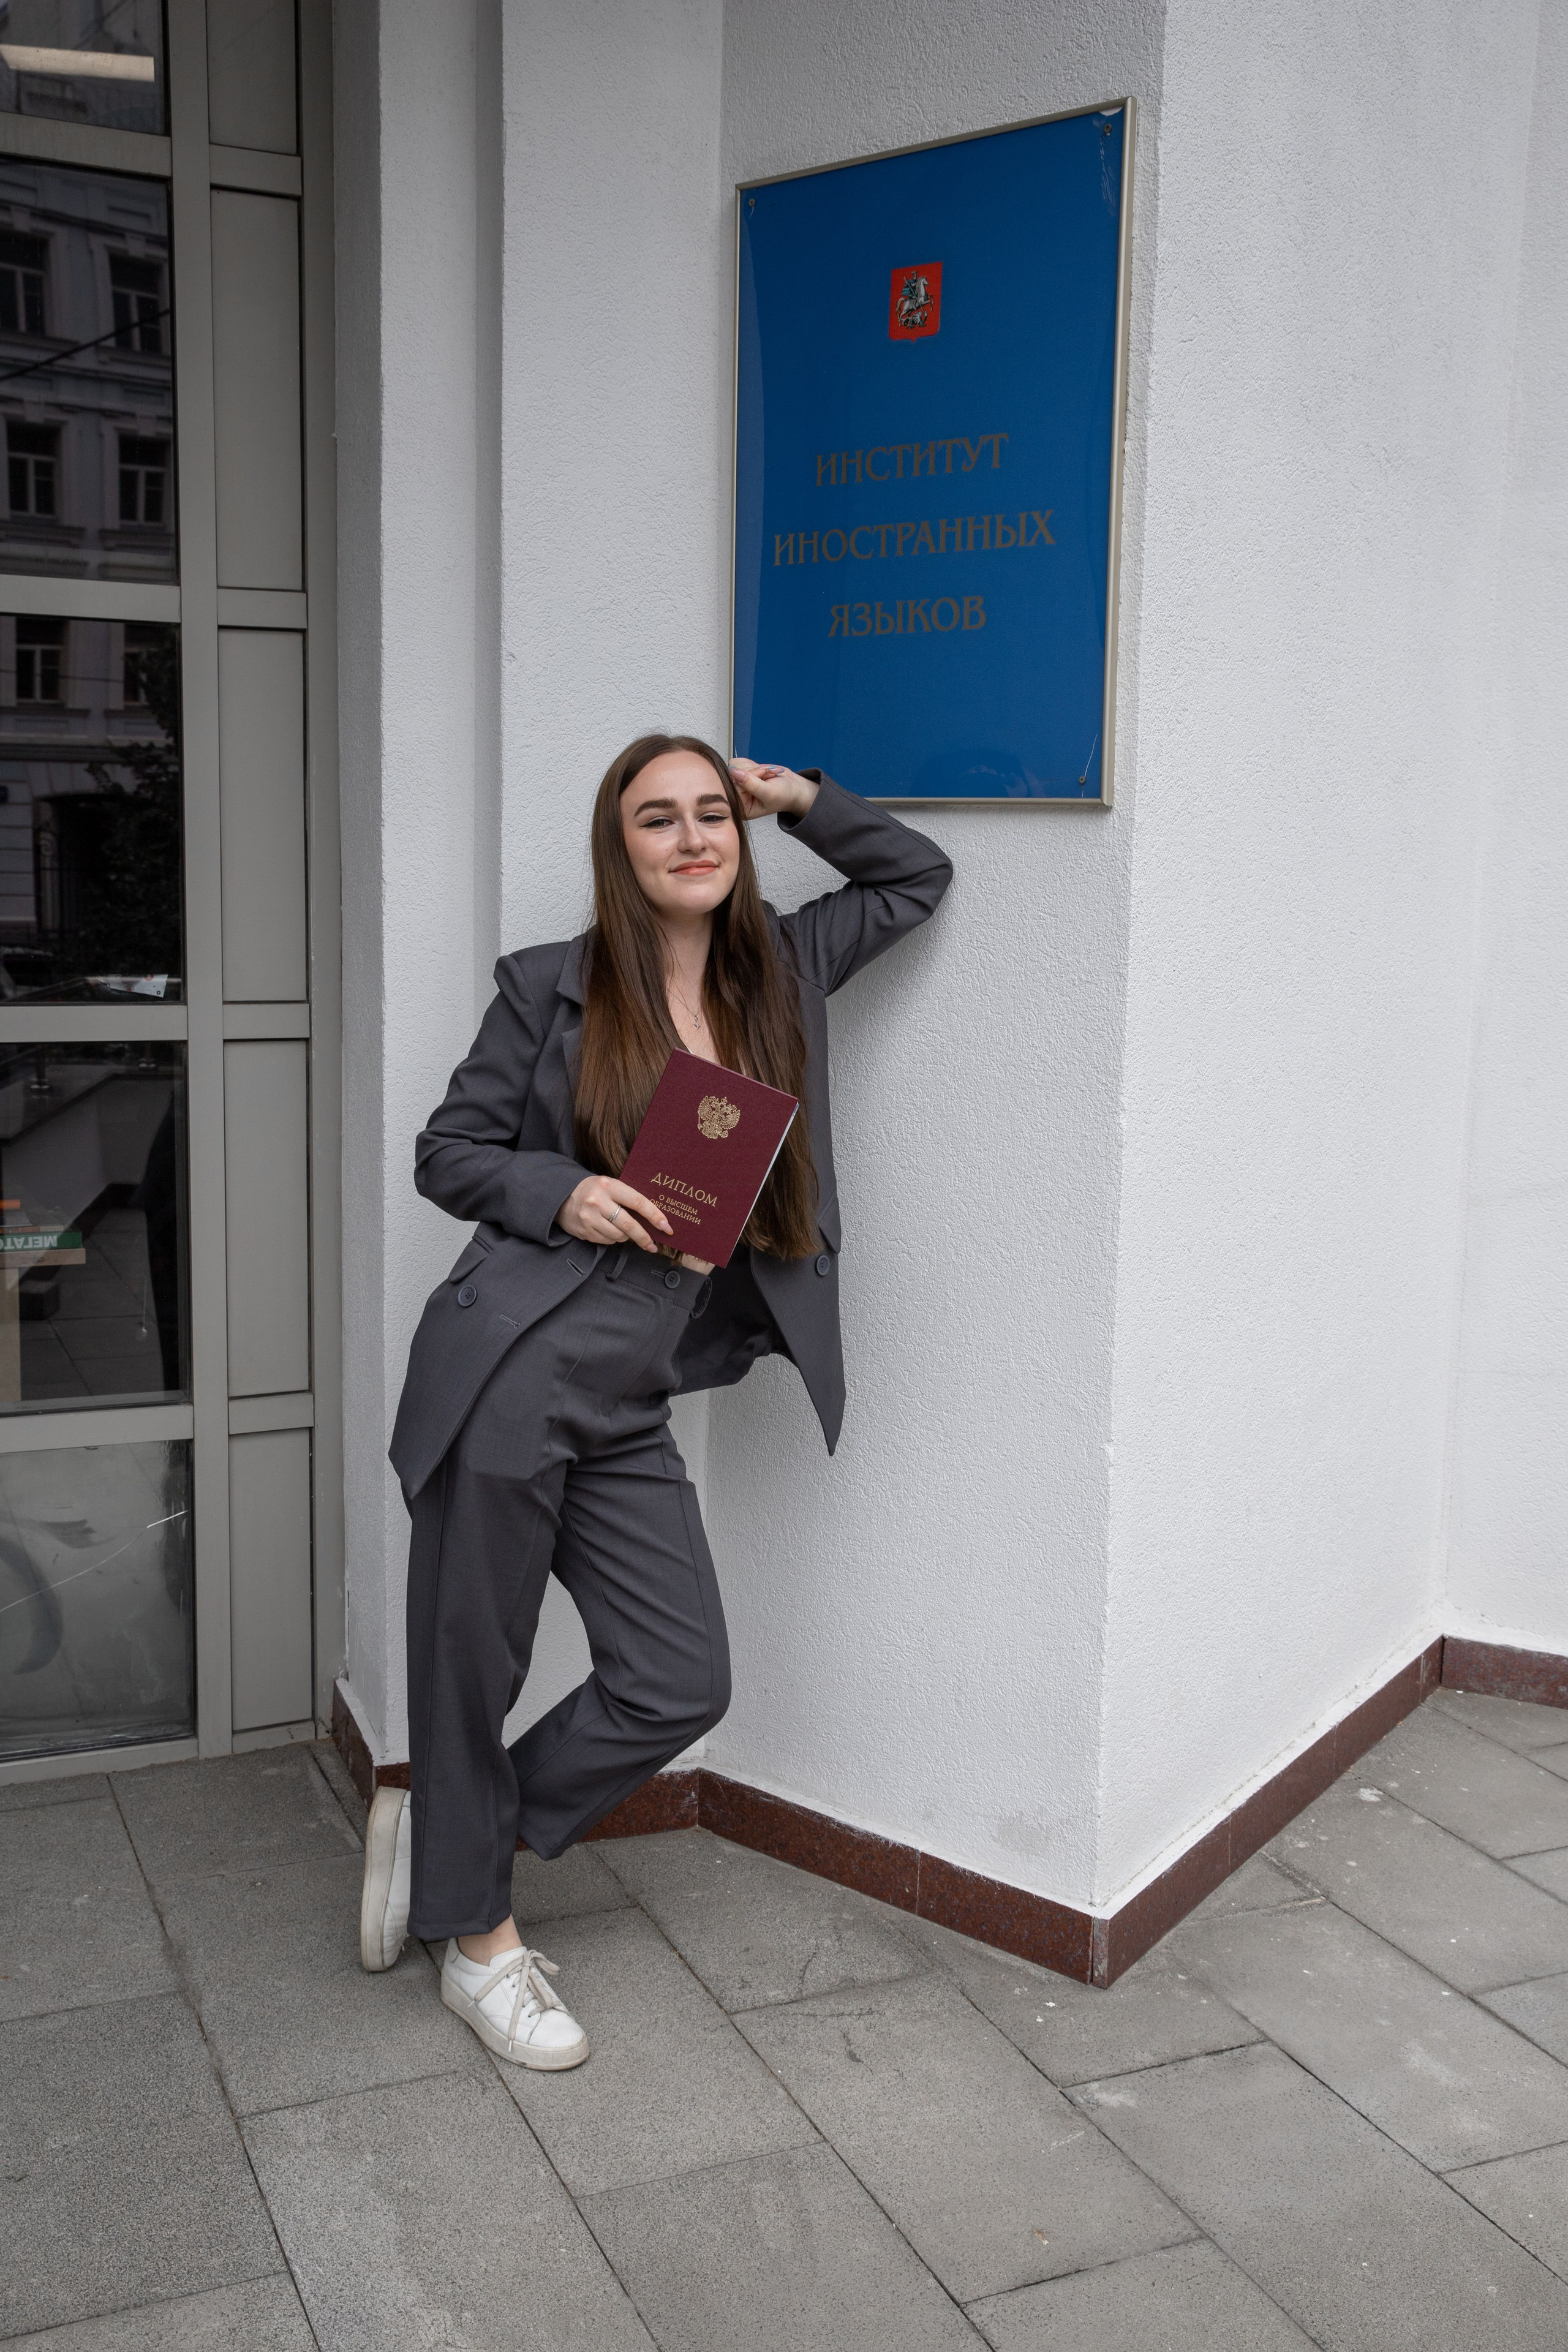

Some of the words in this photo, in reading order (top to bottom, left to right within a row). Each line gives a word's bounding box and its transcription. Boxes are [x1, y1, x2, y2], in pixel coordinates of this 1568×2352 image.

[815, 433, 1009, 487] ИНСТИТУТ
[773, 509, 1057, 567] ИНОСТРАННЫХ
[827, 595, 987, 638] ЯЗЫКОВ
[650, 1172, 718, 1207] ДИПЛОМ
[666, 1197, 698, 1215] ВЫСШЕМ
